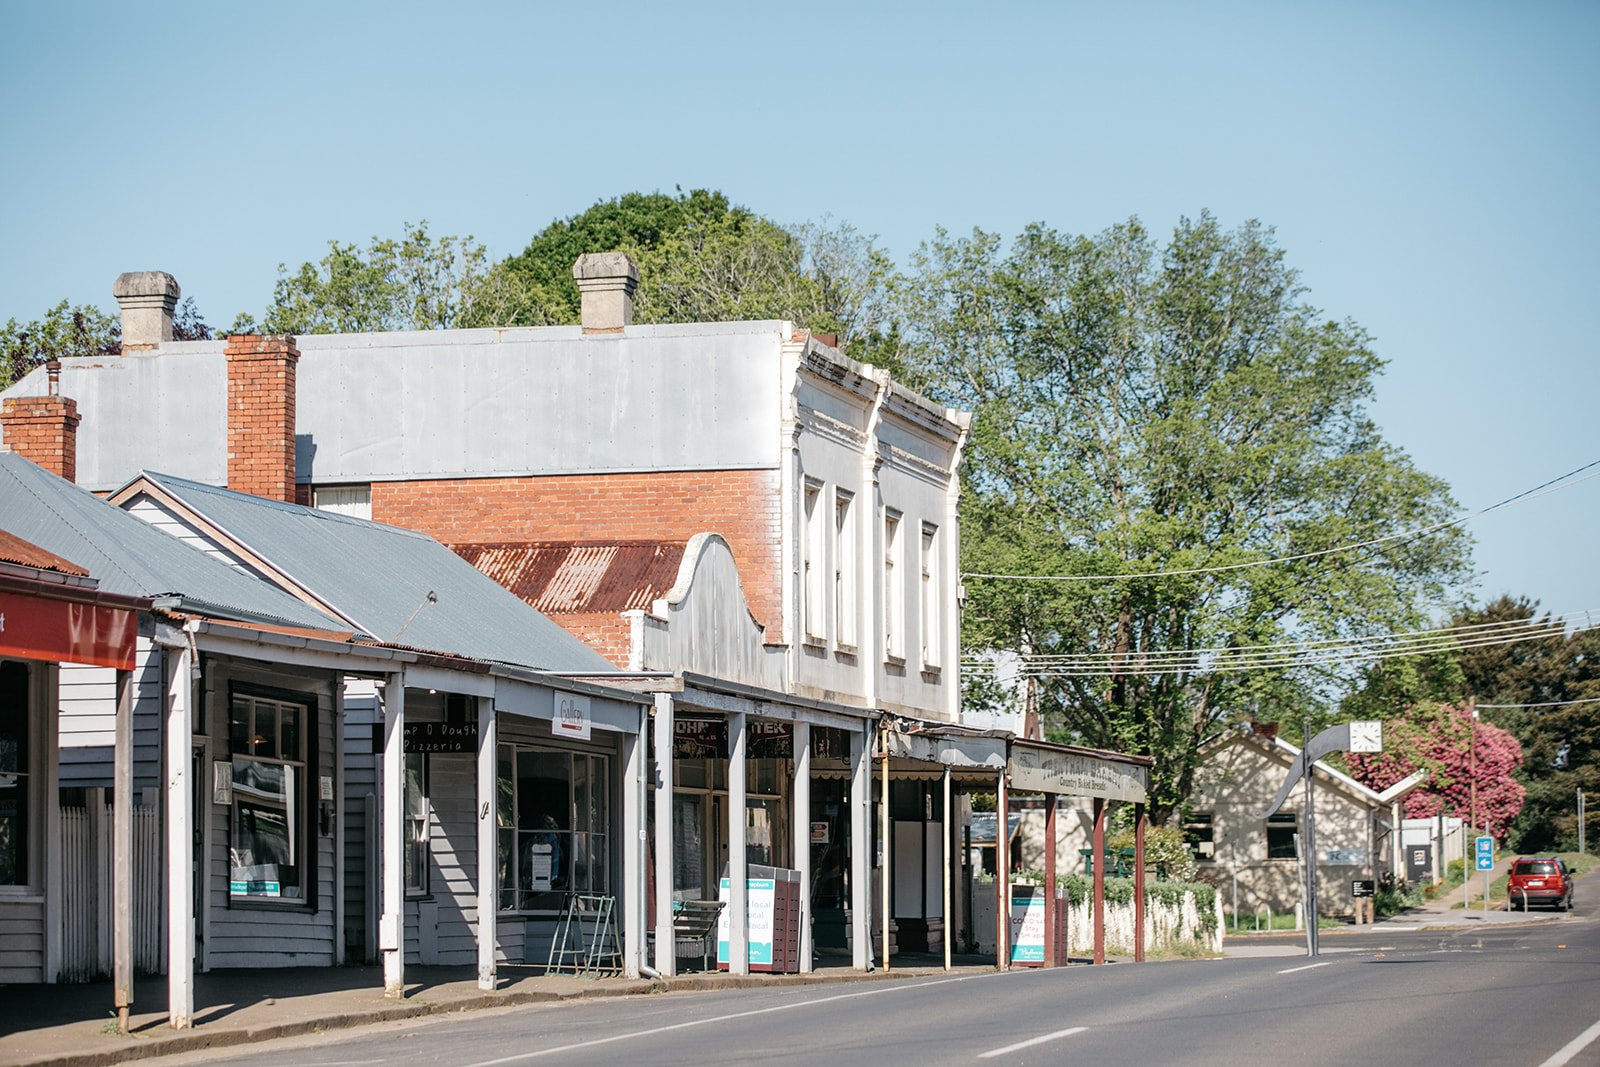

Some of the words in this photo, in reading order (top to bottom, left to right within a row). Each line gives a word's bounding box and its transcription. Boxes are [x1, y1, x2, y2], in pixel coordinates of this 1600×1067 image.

[441, 724, 477, 737] Dough
[673, 721, 710, 734] OHN
[403, 739, 462, 751] Pizzeria
[751, 900, 771, 909] local
[747, 911, 765, 919] ocal
